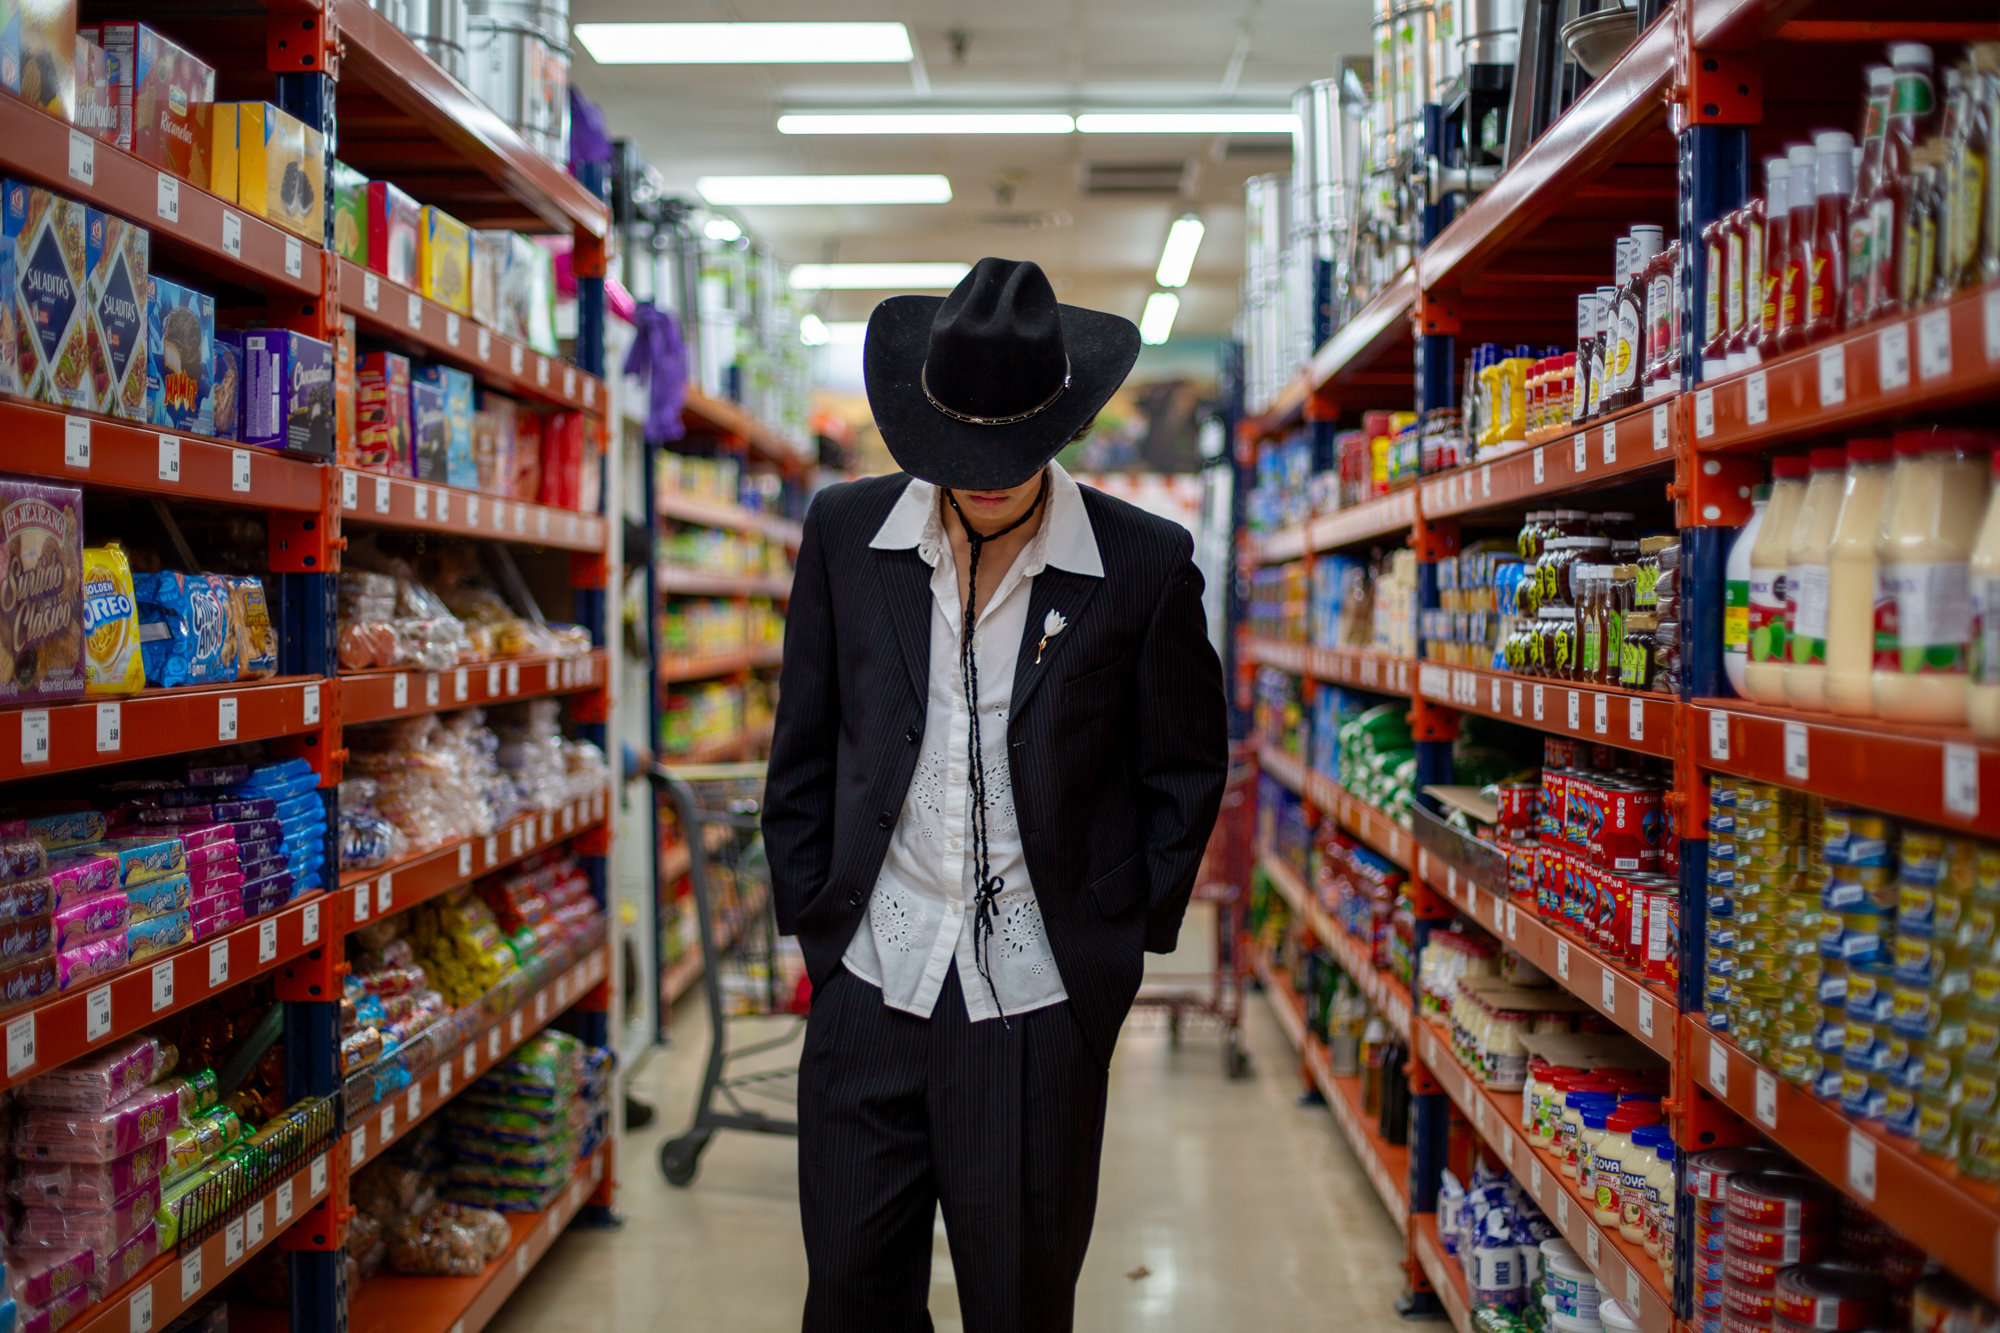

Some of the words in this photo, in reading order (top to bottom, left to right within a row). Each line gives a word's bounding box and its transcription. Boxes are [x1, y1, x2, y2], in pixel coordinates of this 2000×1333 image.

[28, 268, 69, 299] SALADITAS
[104, 295, 135, 322] SALADITAS
[164, 370, 198, 412] MAMUT
[7, 512, 19, 530] EL
[19, 504, 64, 534] MEXICANO
[1, 551, 63, 612] Surtido
[160, 592, 178, 602] WOW
[14, 600, 71, 652] Clásico
[39, 678, 64, 693] Assorted
[64, 677, 84, 691] cookies
[1563, 1122, 1576, 1134] OYA
[1733, 1195, 1765, 1212] SIRENA
[1732, 1227, 1764, 1244] SIRENA
[1731, 1257, 1764, 1275] SIRENA
[1729, 1288, 1762, 1307] SIRENA
